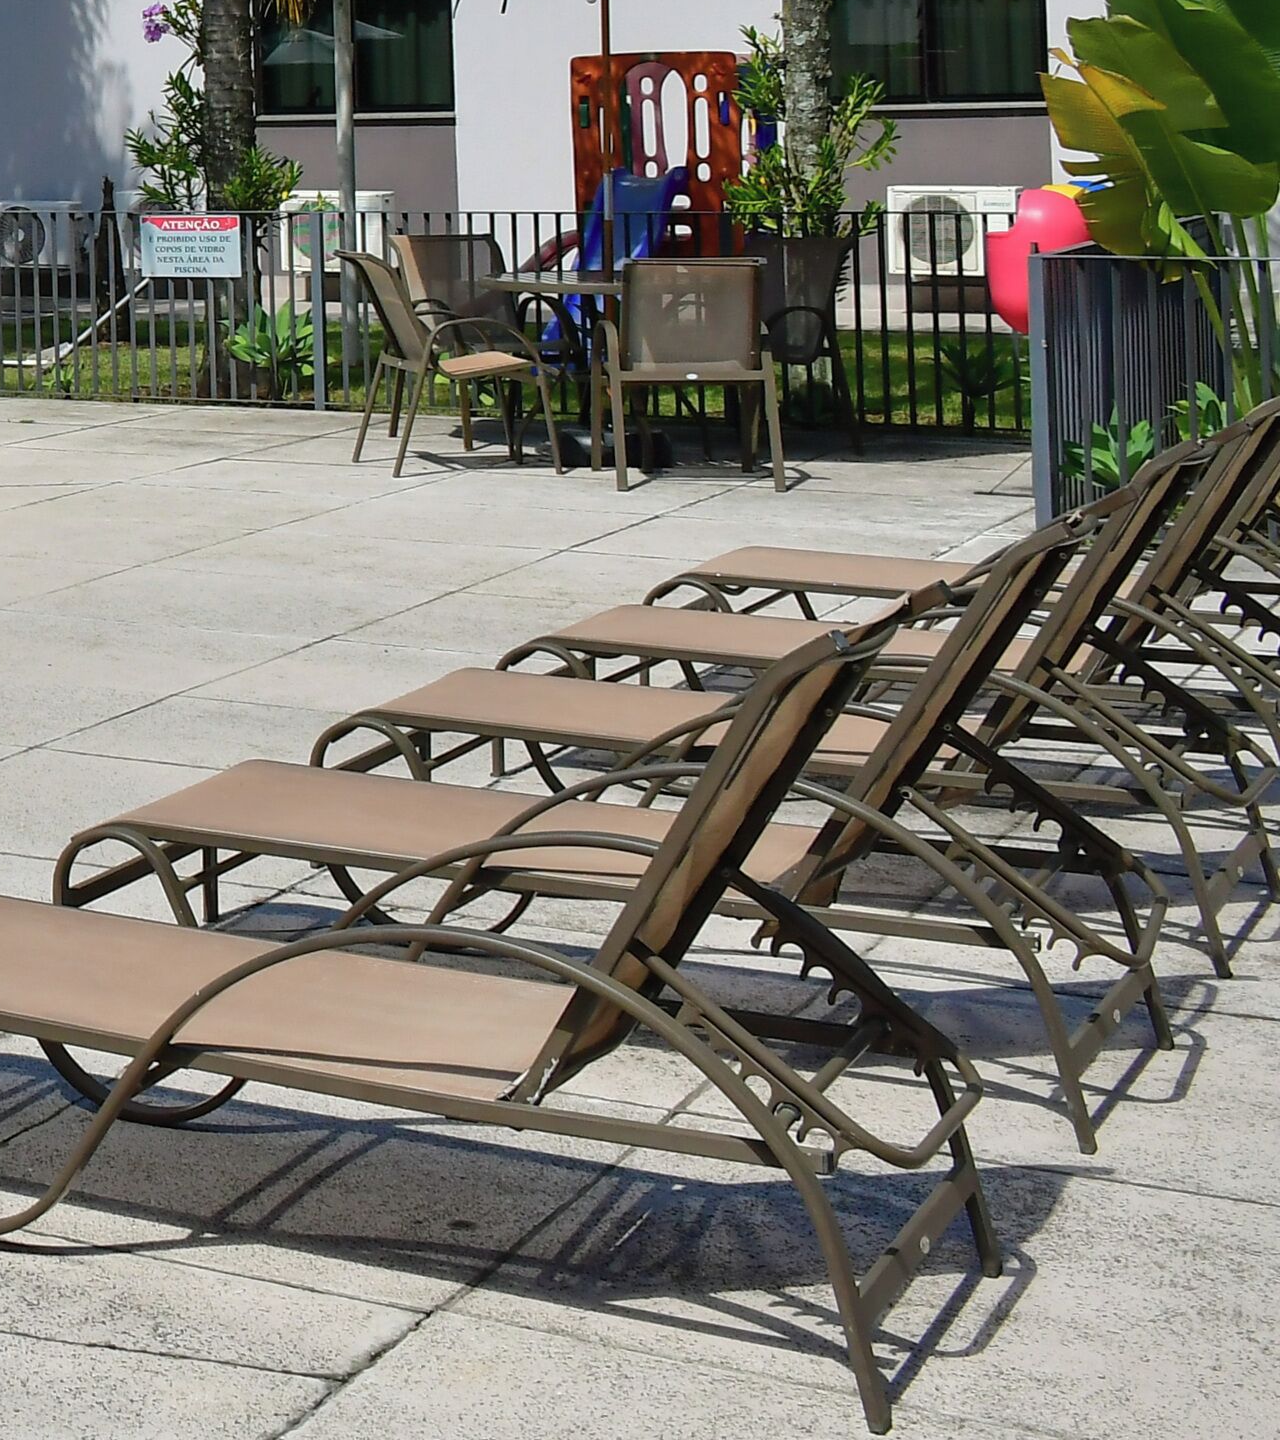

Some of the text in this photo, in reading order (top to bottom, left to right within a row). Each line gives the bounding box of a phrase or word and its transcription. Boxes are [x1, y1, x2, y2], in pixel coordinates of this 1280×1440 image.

[161, 218, 220, 231] ATENÇÃO
[156, 235, 197, 243] PROIBIDO
[199, 235, 217, 243] USO
[219, 235, 232, 243] DE
[154, 245, 226, 253] COPOS DE VIDRO
[156, 255, 185, 263] NESTA
